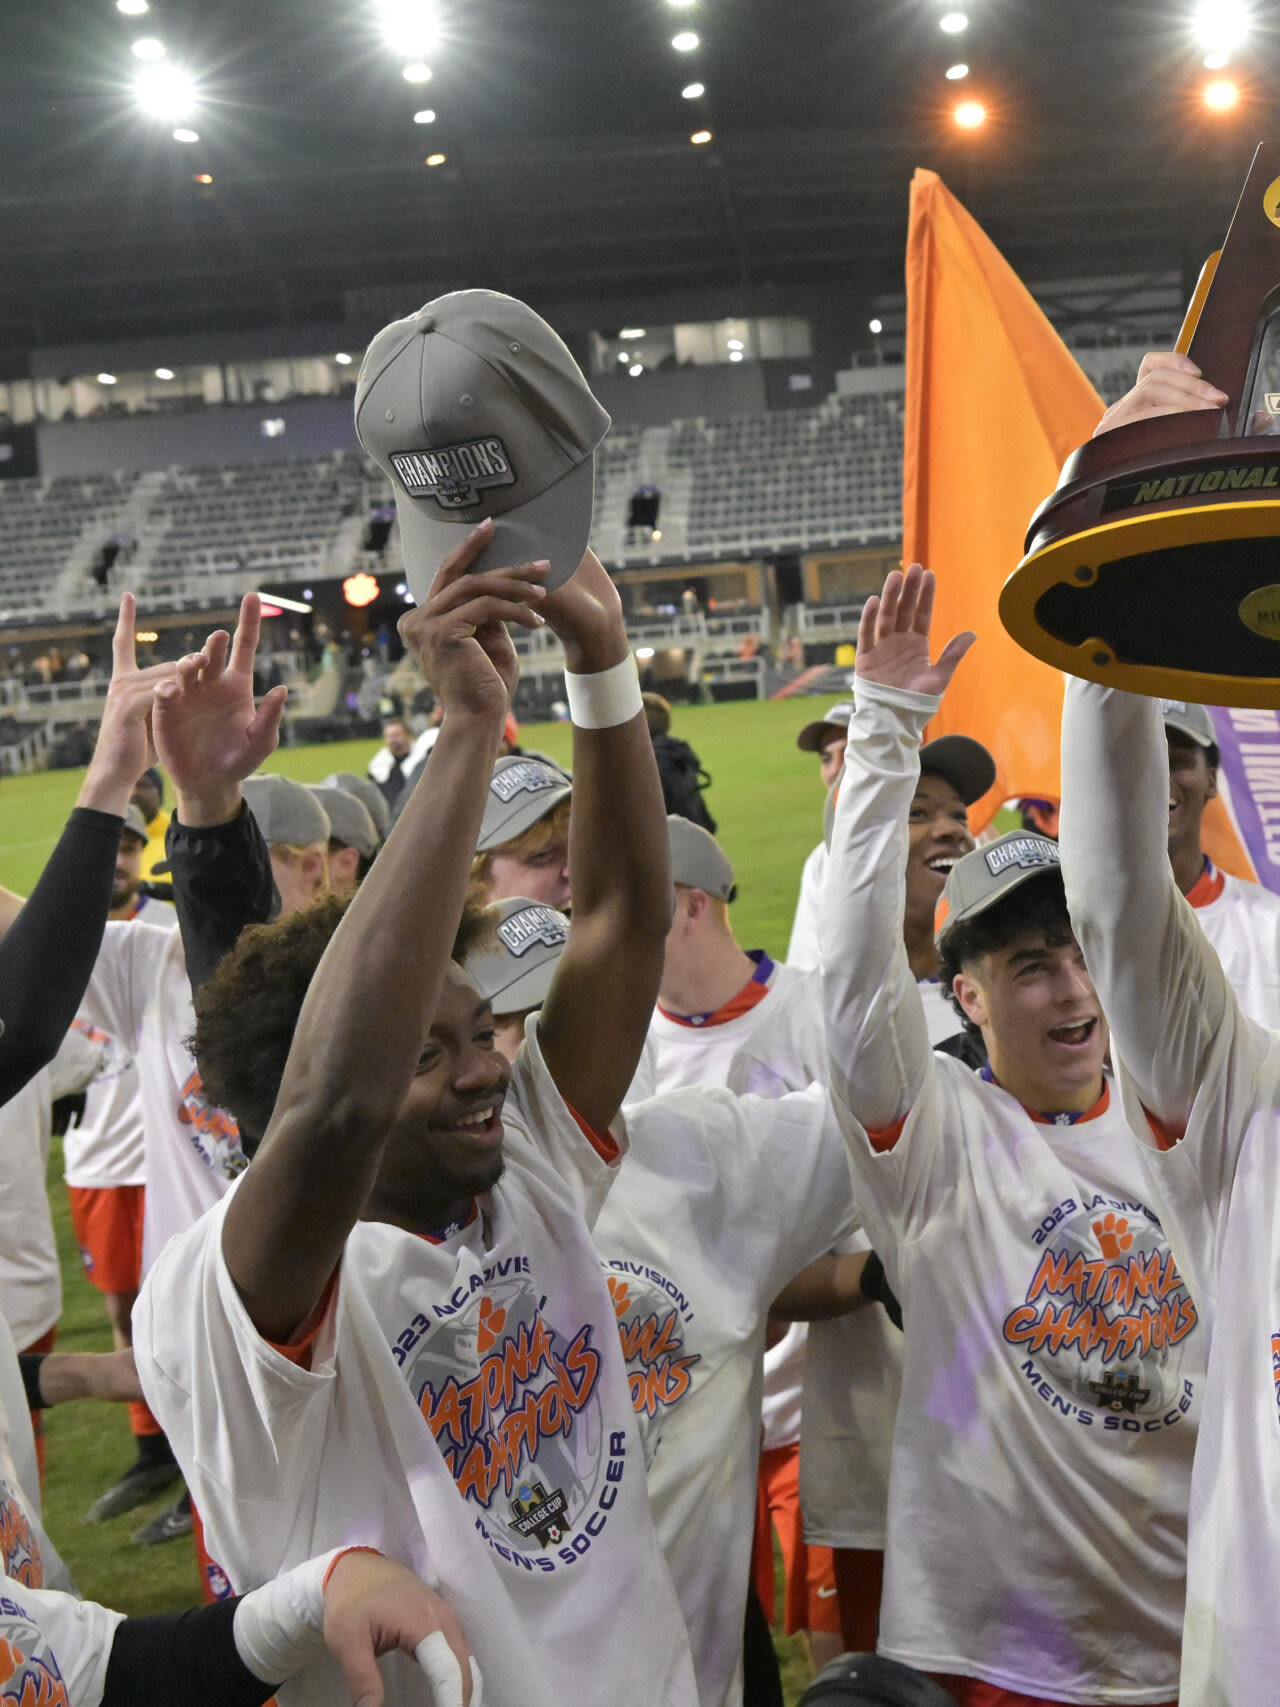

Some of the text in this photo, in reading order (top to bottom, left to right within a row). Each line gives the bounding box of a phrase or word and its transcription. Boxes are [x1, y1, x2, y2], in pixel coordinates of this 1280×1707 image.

[392, 440, 508, 487] CHAMPIONS
[1133, 466, 1279, 504] NATIONAL
[989, 839, 1061, 868] CHAMPION
[1032, 1198, 1078, 1245] 2023
[609, 1260, 694, 1323] DIVISION I
[1020, 1360, 1094, 1426] MEN'S
[518, 1507, 550, 1532] COLLEGE
[546, 1496, 563, 1512] CUP
[558, 1430, 626, 1566] SOCCER
